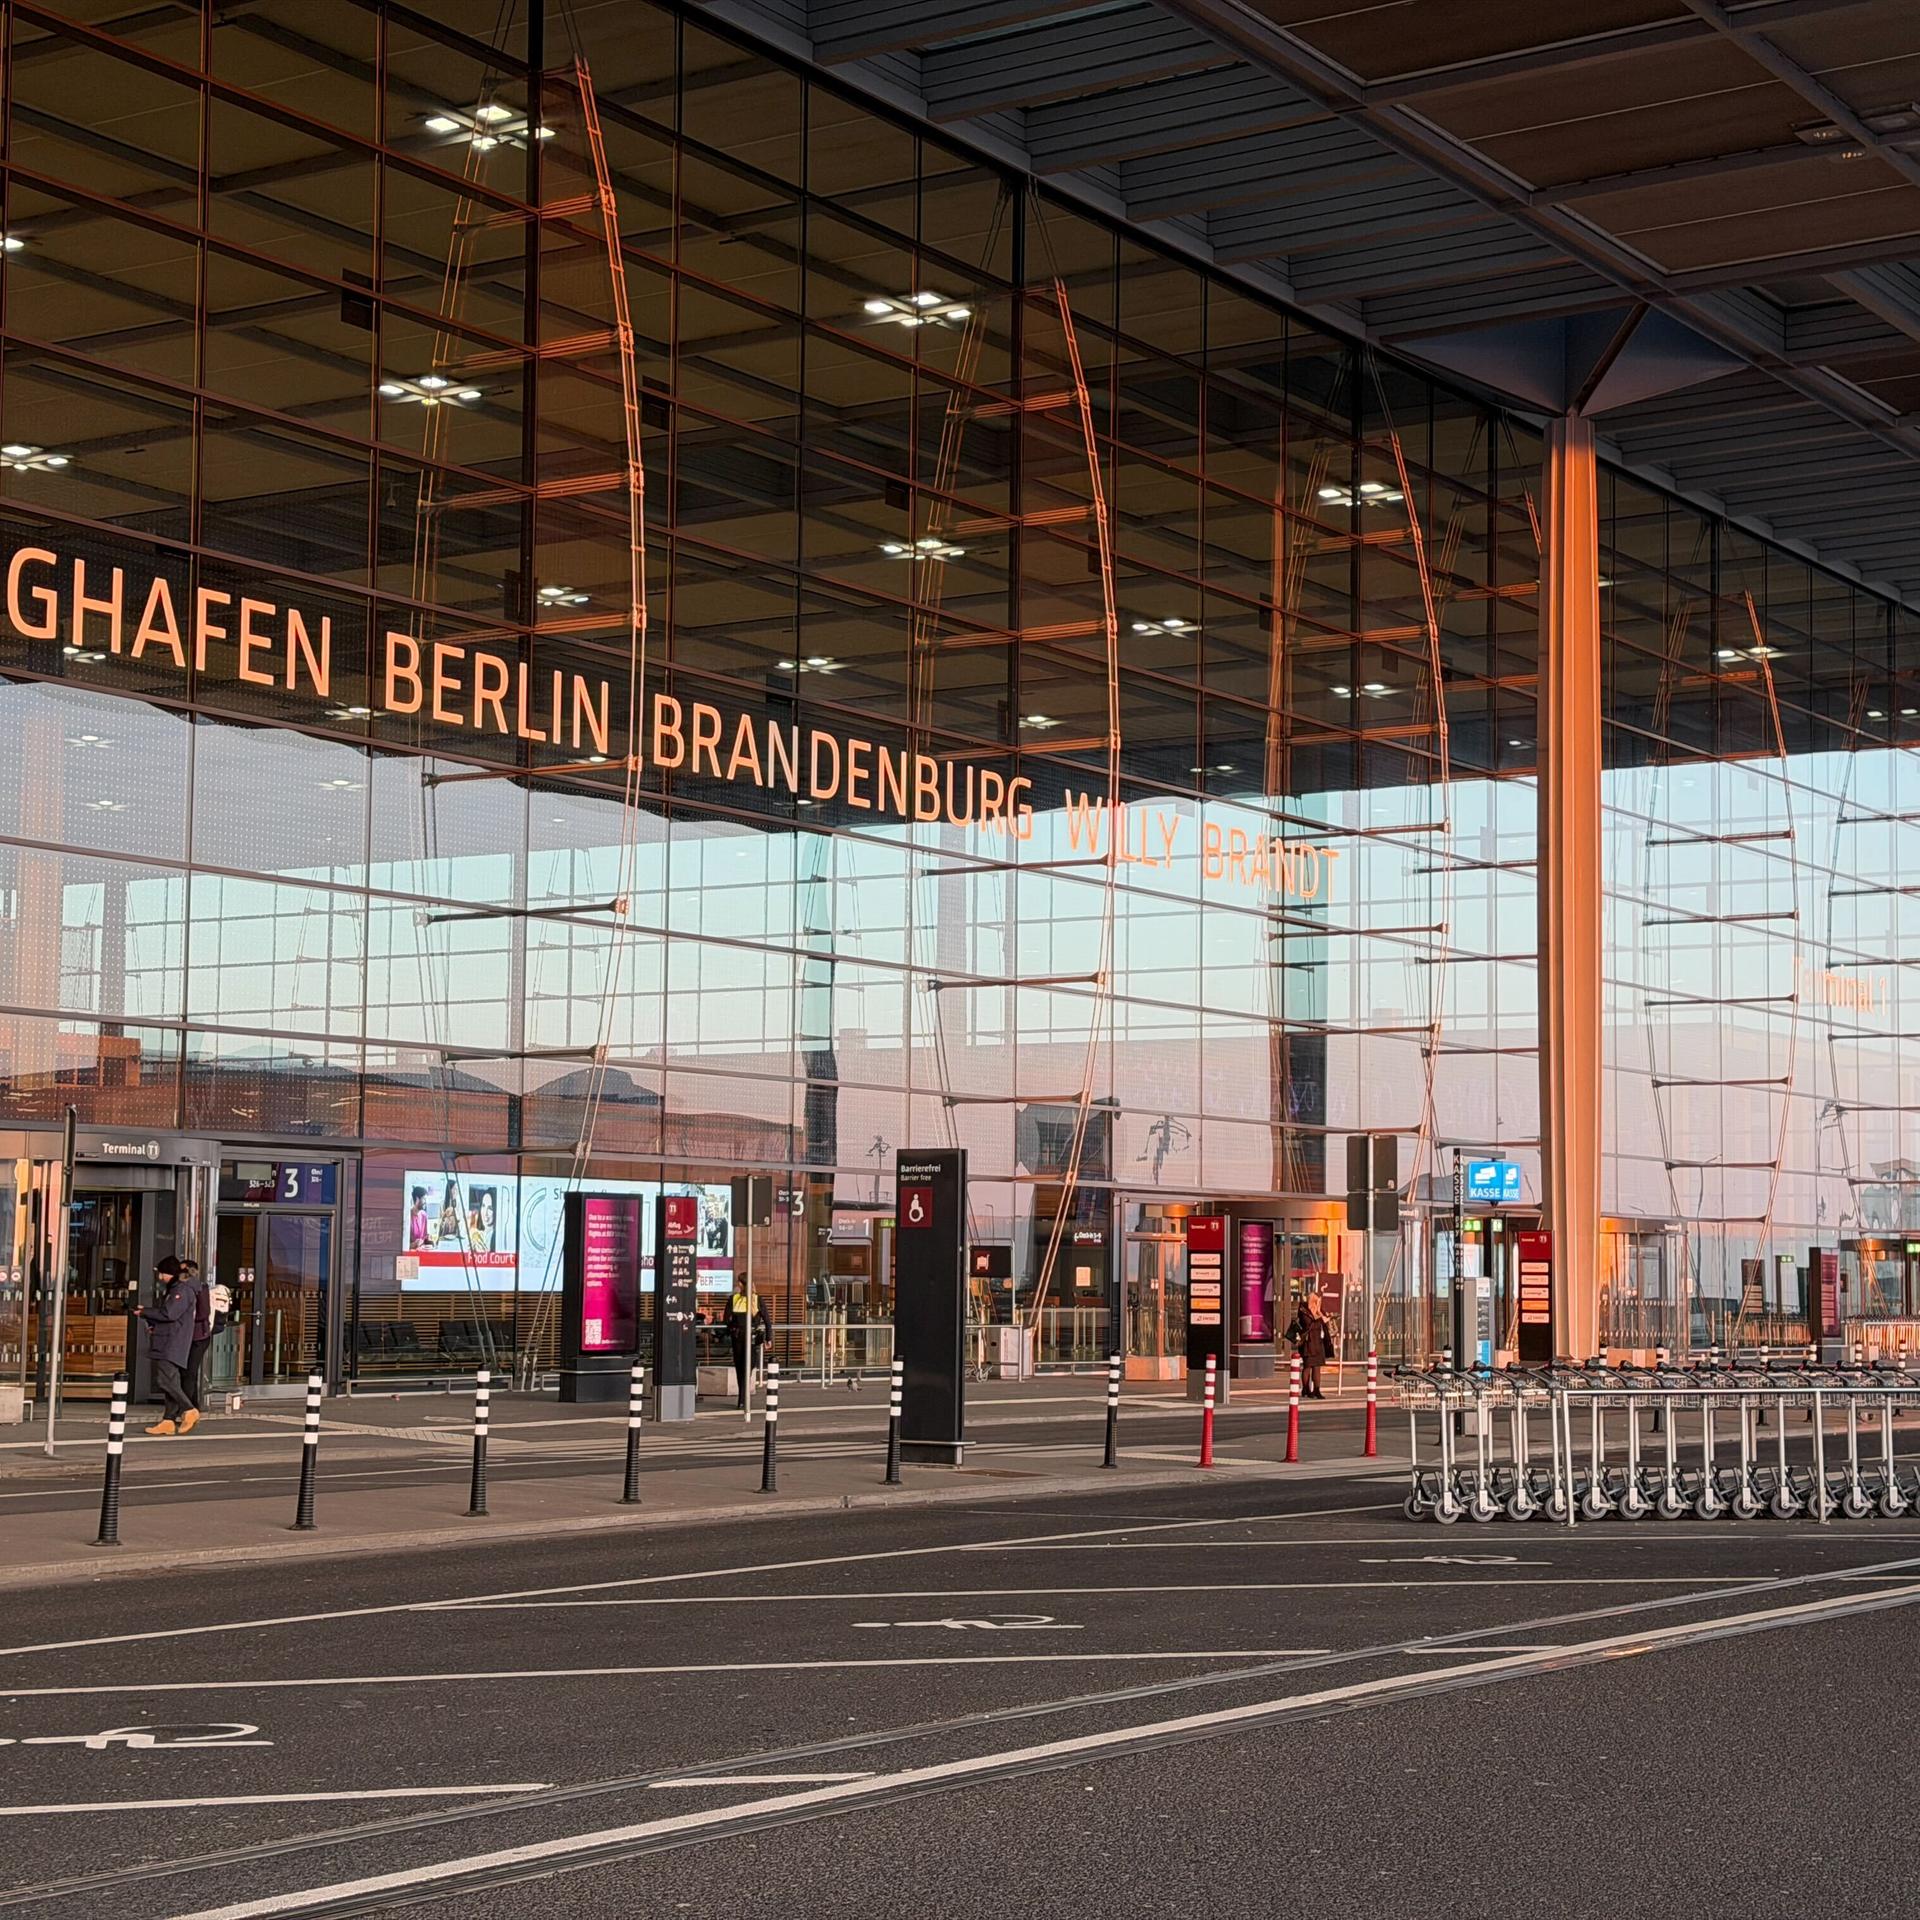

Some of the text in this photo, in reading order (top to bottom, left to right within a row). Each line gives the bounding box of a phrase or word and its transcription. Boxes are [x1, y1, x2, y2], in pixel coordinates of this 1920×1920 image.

[7, 547, 1341, 903] GHAFEN BERLIN BRANDENBURG WILLY BRANDT
[102, 1143, 146, 1155] Terminal
[901, 1164, 941, 1172] Barrierefrei
[284, 1168, 299, 1198] 3
[1470, 1188, 1500, 1198] KASSE
[1503, 1188, 1519, 1199] KASSE
[792, 1191, 804, 1216] 3
[863, 1218, 869, 1236] 1
[826, 1228, 832, 1243] 2
[490, 1252, 515, 1265] Court
